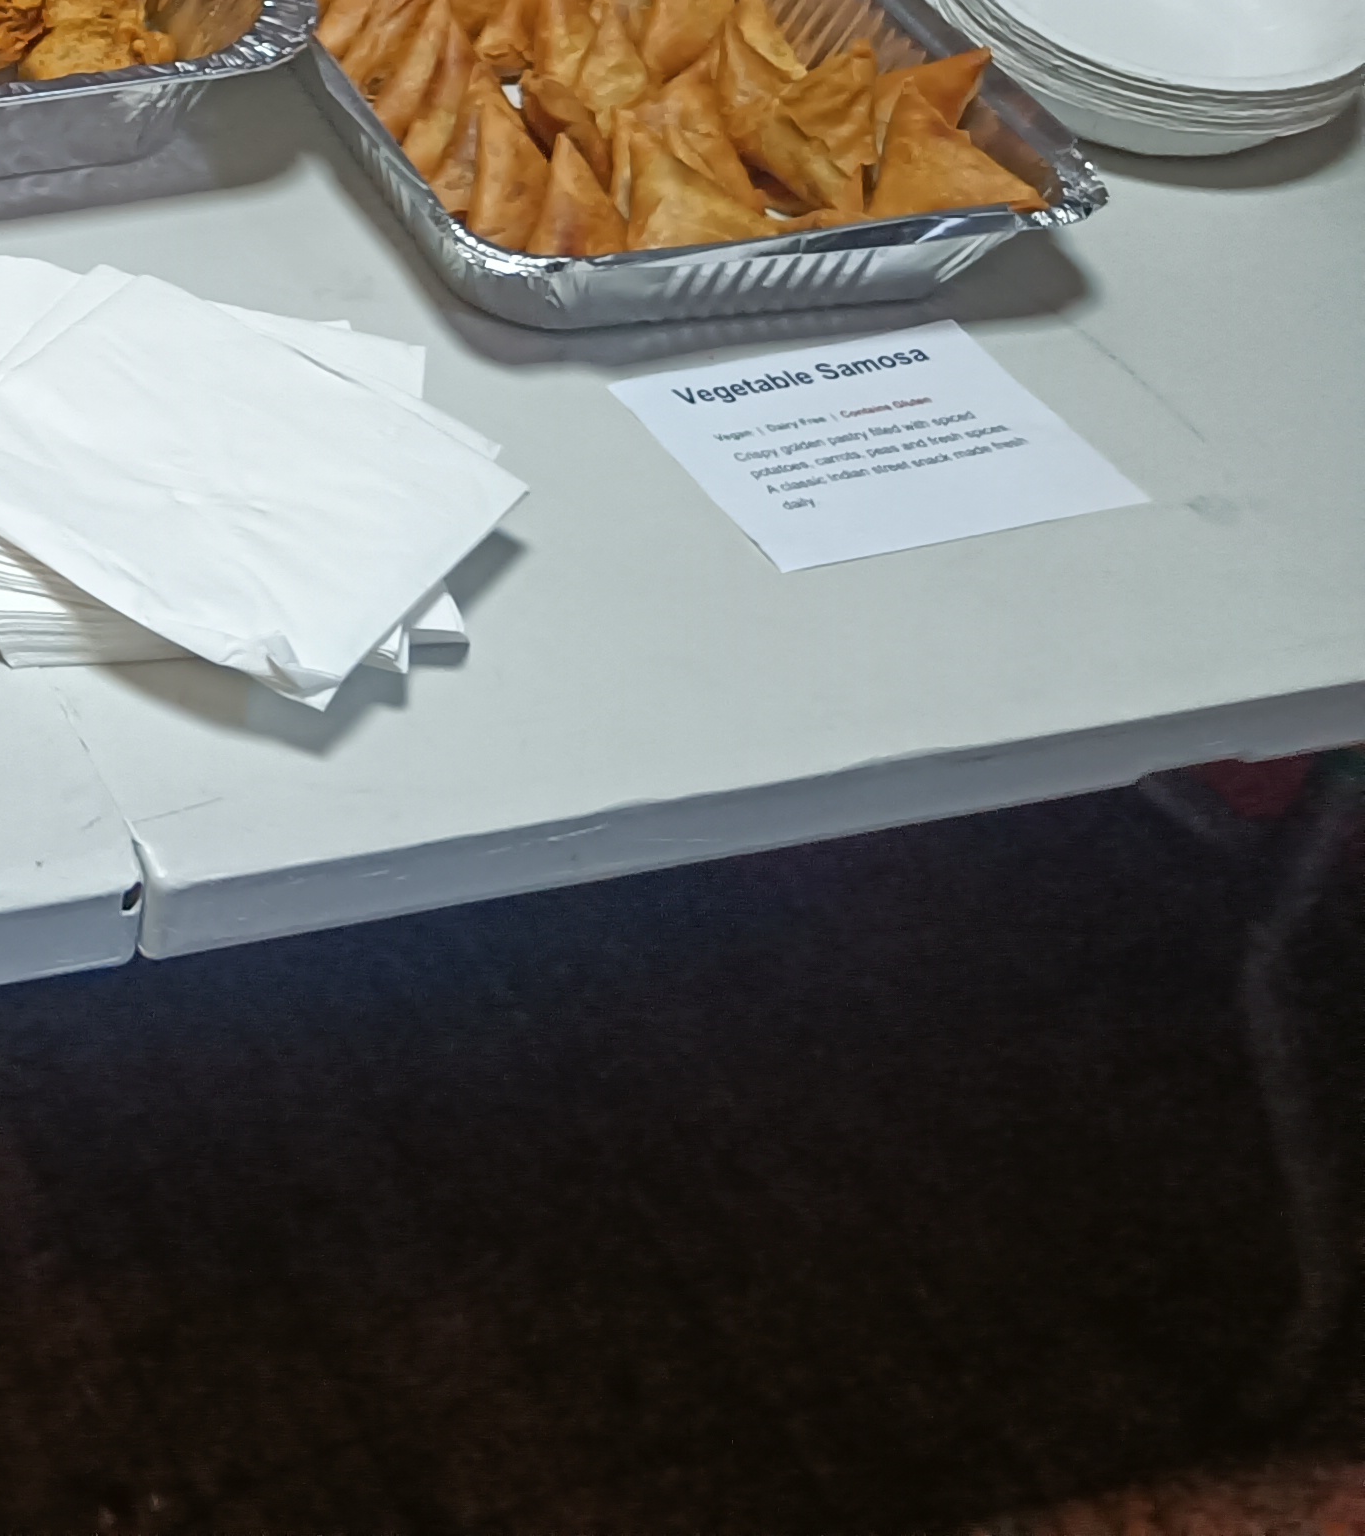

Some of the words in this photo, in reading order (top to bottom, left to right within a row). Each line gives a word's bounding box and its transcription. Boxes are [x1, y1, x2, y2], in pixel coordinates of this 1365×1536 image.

[671, 369, 815, 404] Vegetable
[815, 348, 930, 380] Samosa
[733, 448, 779, 462] Crispy
[780, 439, 826, 455] golden
[827, 431, 869, 446] pastry
[902, 419, 931, 431] with
[931, 410, 977, 426] spiced
[866, 445, 900, 458] peas
[901, 438, 928, 451] and
[927, 432, 964, 445] fresh
[767, 484, 780, 494] A
[780, 475, 827, 491] classic
[827, 468, 871, 481] Indian
[871, 461, 911, 474] street
[911, 453, 953, 467] snack
[953, 445, 993, 459] made
[991, 437, 1030, 450] fresh
